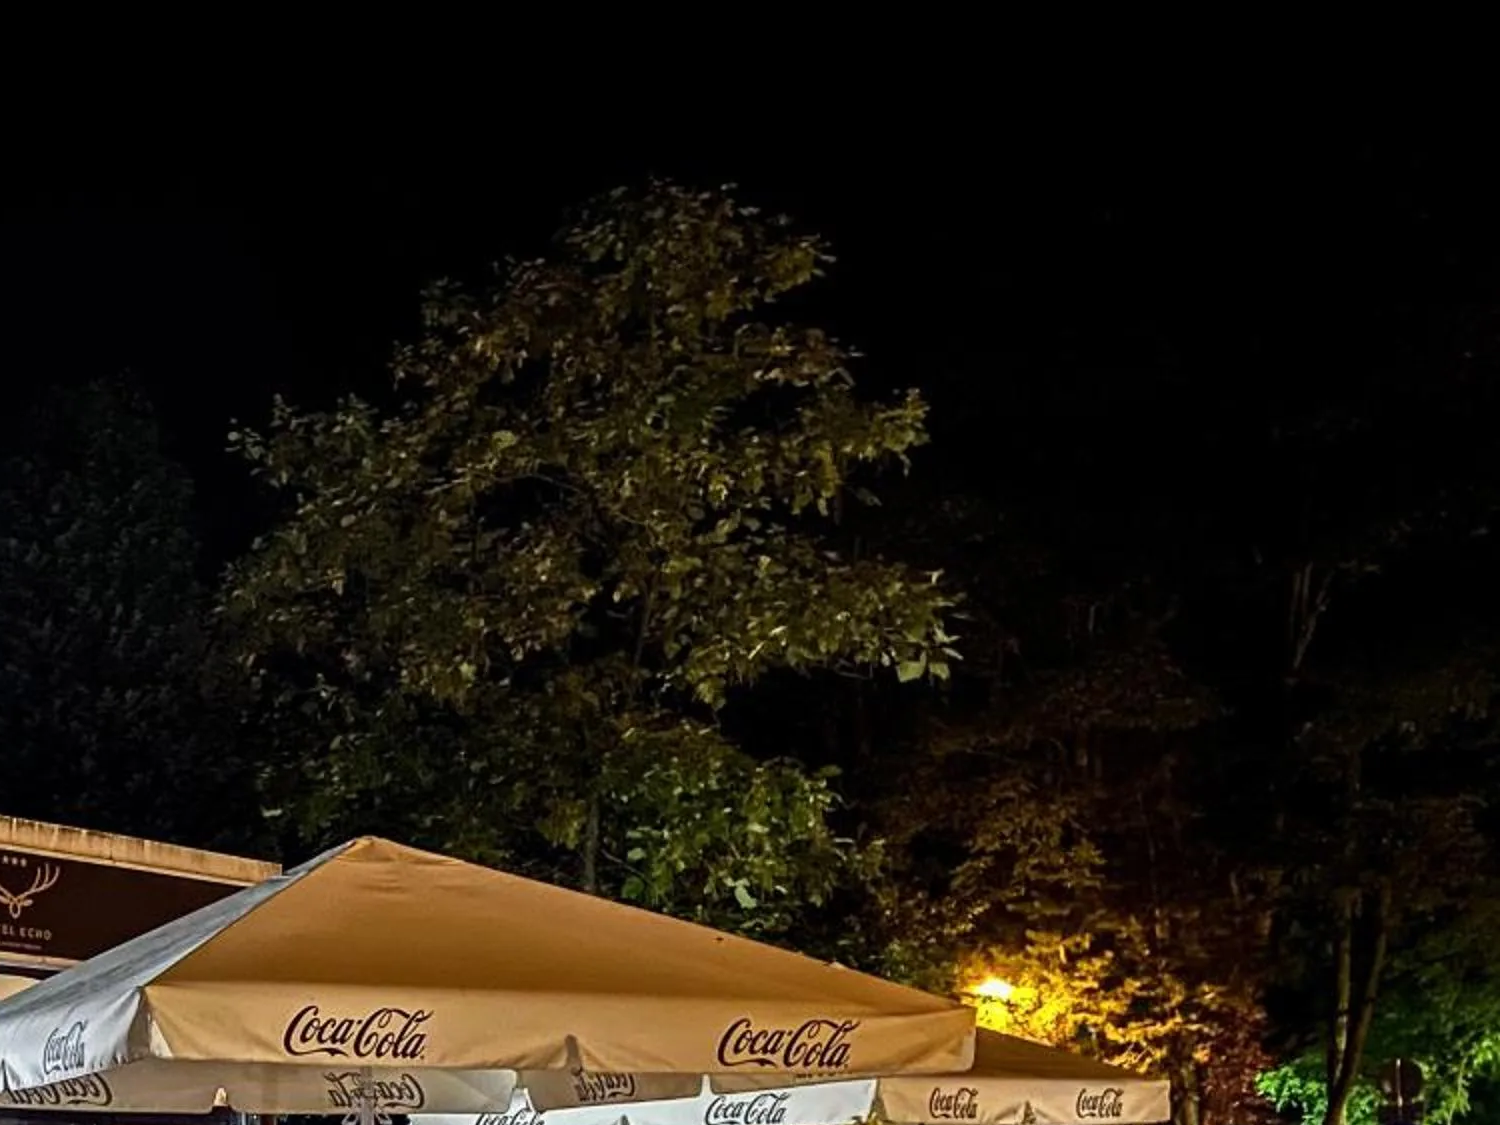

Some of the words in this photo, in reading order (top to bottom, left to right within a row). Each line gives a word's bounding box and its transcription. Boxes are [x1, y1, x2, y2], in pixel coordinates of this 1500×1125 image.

[20, 926, 52, 941] ECHO
[283, 1005, 434, 1060] Coca-Cola
[717, 1017, 861, 1068] Coca-Cola
[929, 1087, 979, 1119] Coca-Cola
[1076, 1088, 1125, 1119] Coca-Cola
